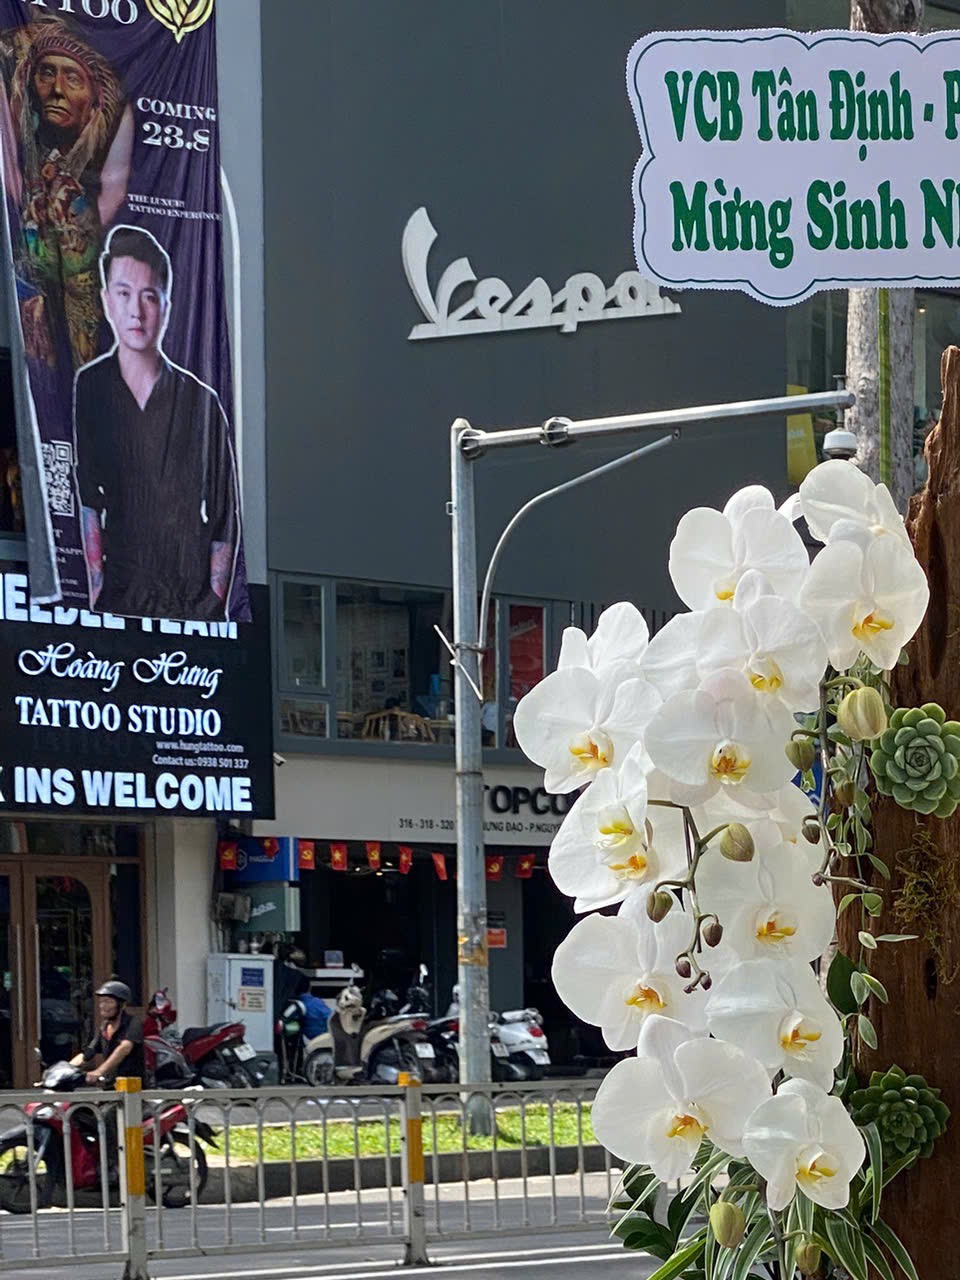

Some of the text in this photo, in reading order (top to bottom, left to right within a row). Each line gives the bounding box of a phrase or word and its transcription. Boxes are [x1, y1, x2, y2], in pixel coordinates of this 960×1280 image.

[137, 97, 216, 121] COMING
[664, 70, 741, 141] VCB
[752, 67, 818, 141] Tân
[829, 70, 914, 161] Định
[142, 121, 210, 152] 23.8
[128, 193, 150, 203] THE
[128, 203, 166, 216] TATTOO
[669, 179, 793, 269] Mừng
[807, 179, 908, 250] Sinh
[402, 206, 682, 340] Vespa
[18, 642, 125, 692] Hoàng
[15, 696, 221, 737] TATTOO STUDIO
[152, 754, 183, 766] Contact
[219, 758, 233, 768] 501
[234, 759, 249, 769] 337
[156, 739, 244, 753] www.hungtattoo.com
[15, 766, 75, 806] INS
[82, 770, 252, 812] WELCOME
